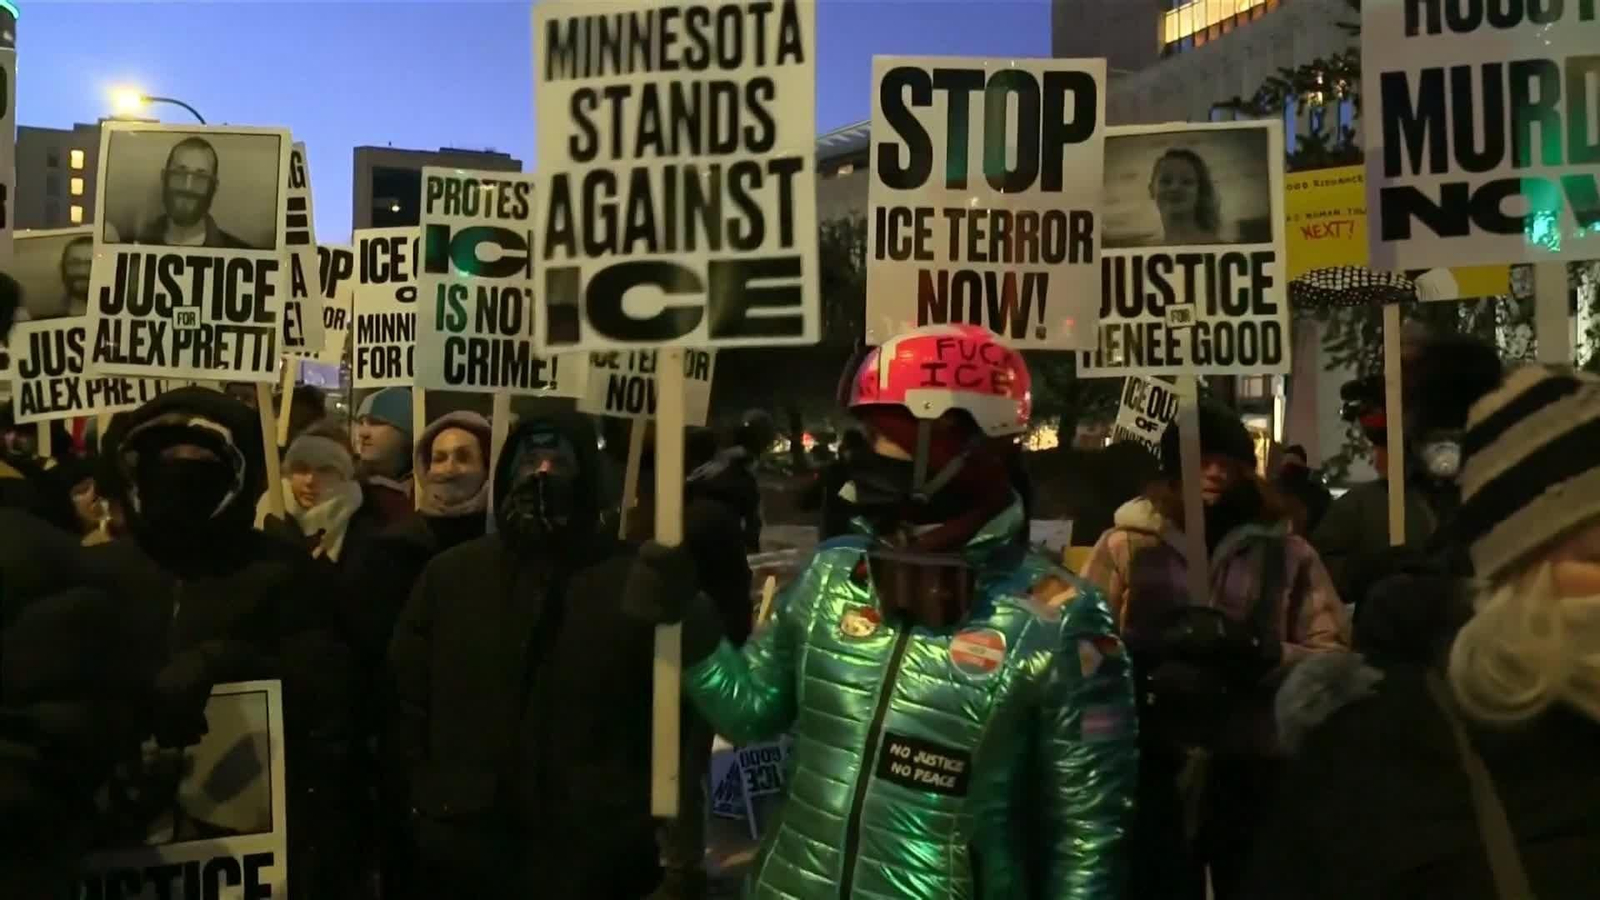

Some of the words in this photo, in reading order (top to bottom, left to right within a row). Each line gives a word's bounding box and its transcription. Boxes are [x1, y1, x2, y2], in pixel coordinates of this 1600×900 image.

[545, 0, 804, 82] MINNESOTA
[569, 76, 777, 163] STANDS
[877, 66, 1097, 193] STOP
[1380, 55, 1600, 178] MURD
[426, 175, 534, 220] PROTES
[543, 157, 804, 260] AGAINST
[360, 237, 408, 284] ICE
[425, 224, 532, 279] IC
[875, 206, 934, 261] ICE
[944, 207, 1093, 264] TERROR
[101, 253, 278, 323] JUSTICE
[436, 283, 468, 333] IS
[545, 256, 804, 346] ICE
[917, 269, 1049, 340] NOW!
[1099, 251, 1277, 319] JUSTICE
[176, 311, 196, 325] FOR
[1191, 320, 1282, 367] GOOD
[18, 327, 86, 379] JUS
[93, 319, 166, 367] ALEX
[172, 325, 275, 373] PRETTI
[357, 346, 401, 379] FOR
[444, 336, 558, 391] CRIME!
[20, 377, 82, 416] ALEX
[920, 363, 1014, 396] ICE
[1135, 416, 1158, 432] OF
[889, 743, 909, 759] NO
[913, 751, 966, 773] JUSTICE
[890, 762, 910, 777] NO
[914, 769, 957, 788] PEACE
